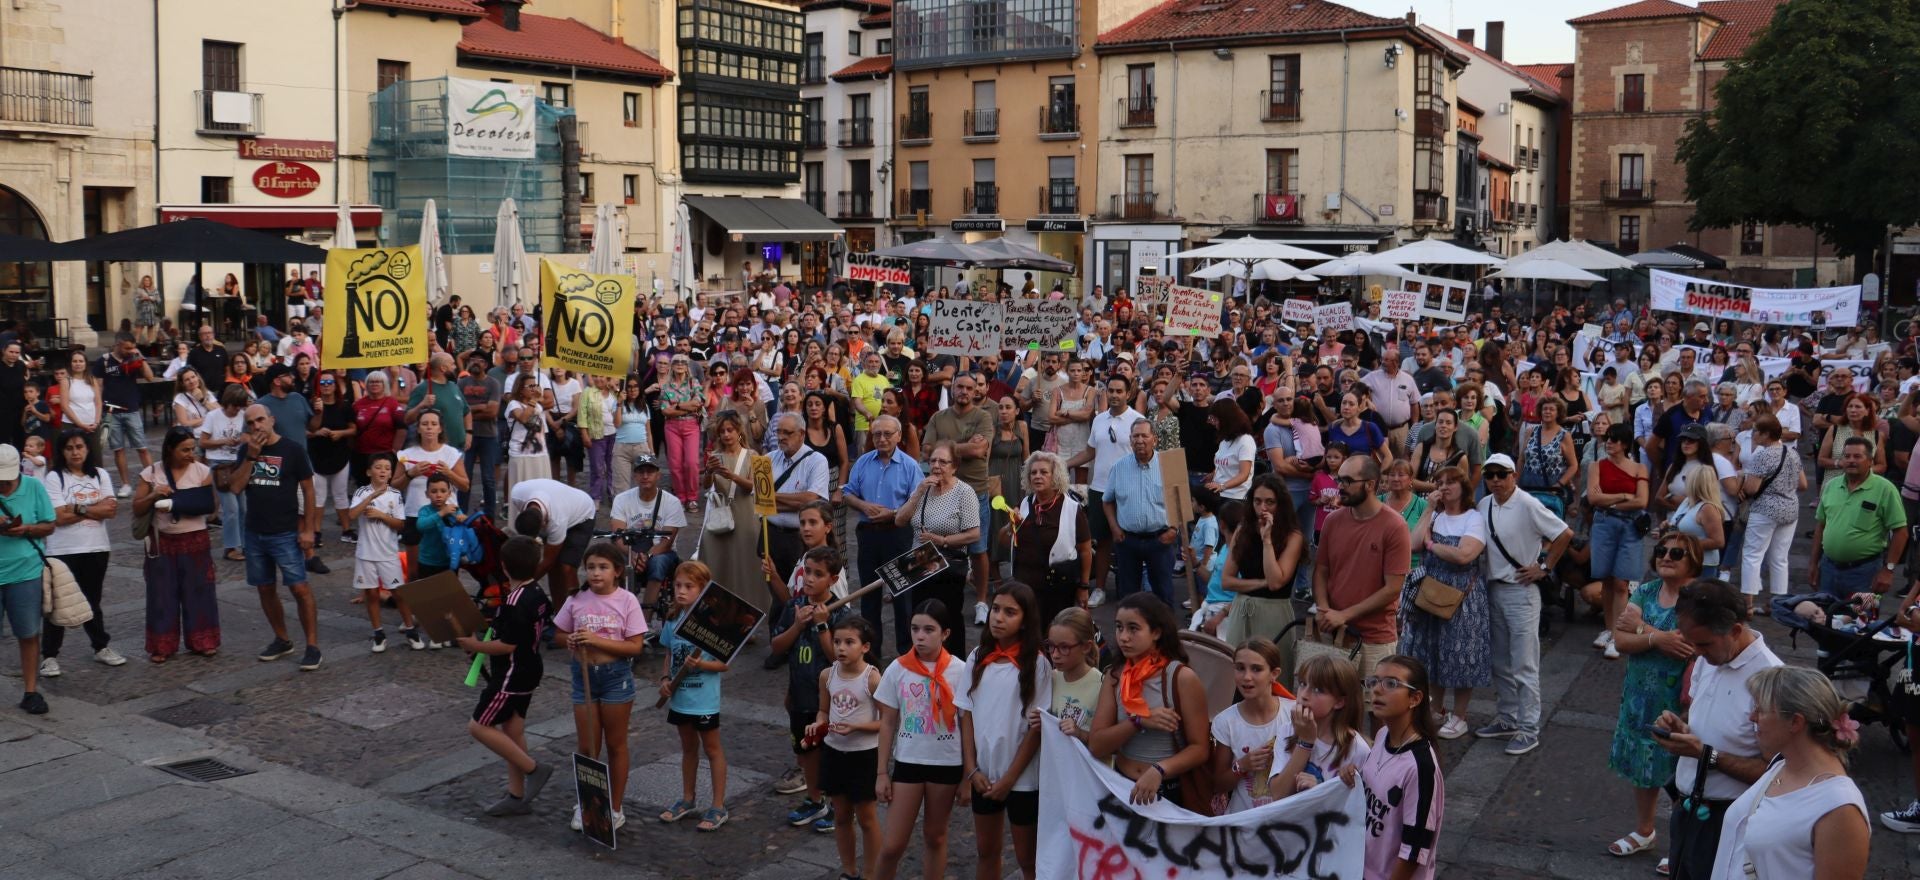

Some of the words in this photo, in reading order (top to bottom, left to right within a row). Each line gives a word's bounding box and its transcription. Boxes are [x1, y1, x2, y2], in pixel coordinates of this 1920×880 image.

[242, 140, 334, 158] Restaurante
[276, 162, 300, 174] Bar
[271, 177, 319, 193] Capricho
[1686, 282, 1751, 300] ALCALDE
[935, 300, 981, 318] Puente
[1287, 301, 1312, 311] BIOMASA
[1319, 306, 1346, 317] ALCALDE
[956, 318, 1000, 333] Castro
[1016, 314, 1042, 325] puede
[1005, 326, 1013, 335] de
[1016, 324, 1050, 334] rodillas
[362, 337, 414, 349] INCINERADORA
[365, 349, 389, 358] PUENTE
[390, 347, 414, 356] CASTRO
[559, 346, 614, 363] INCINERADORA
[561, 356, 585, 367] PUENTE
[587, 361, 613, 371] CASTRO
[799, 646, 812, 663] 10
